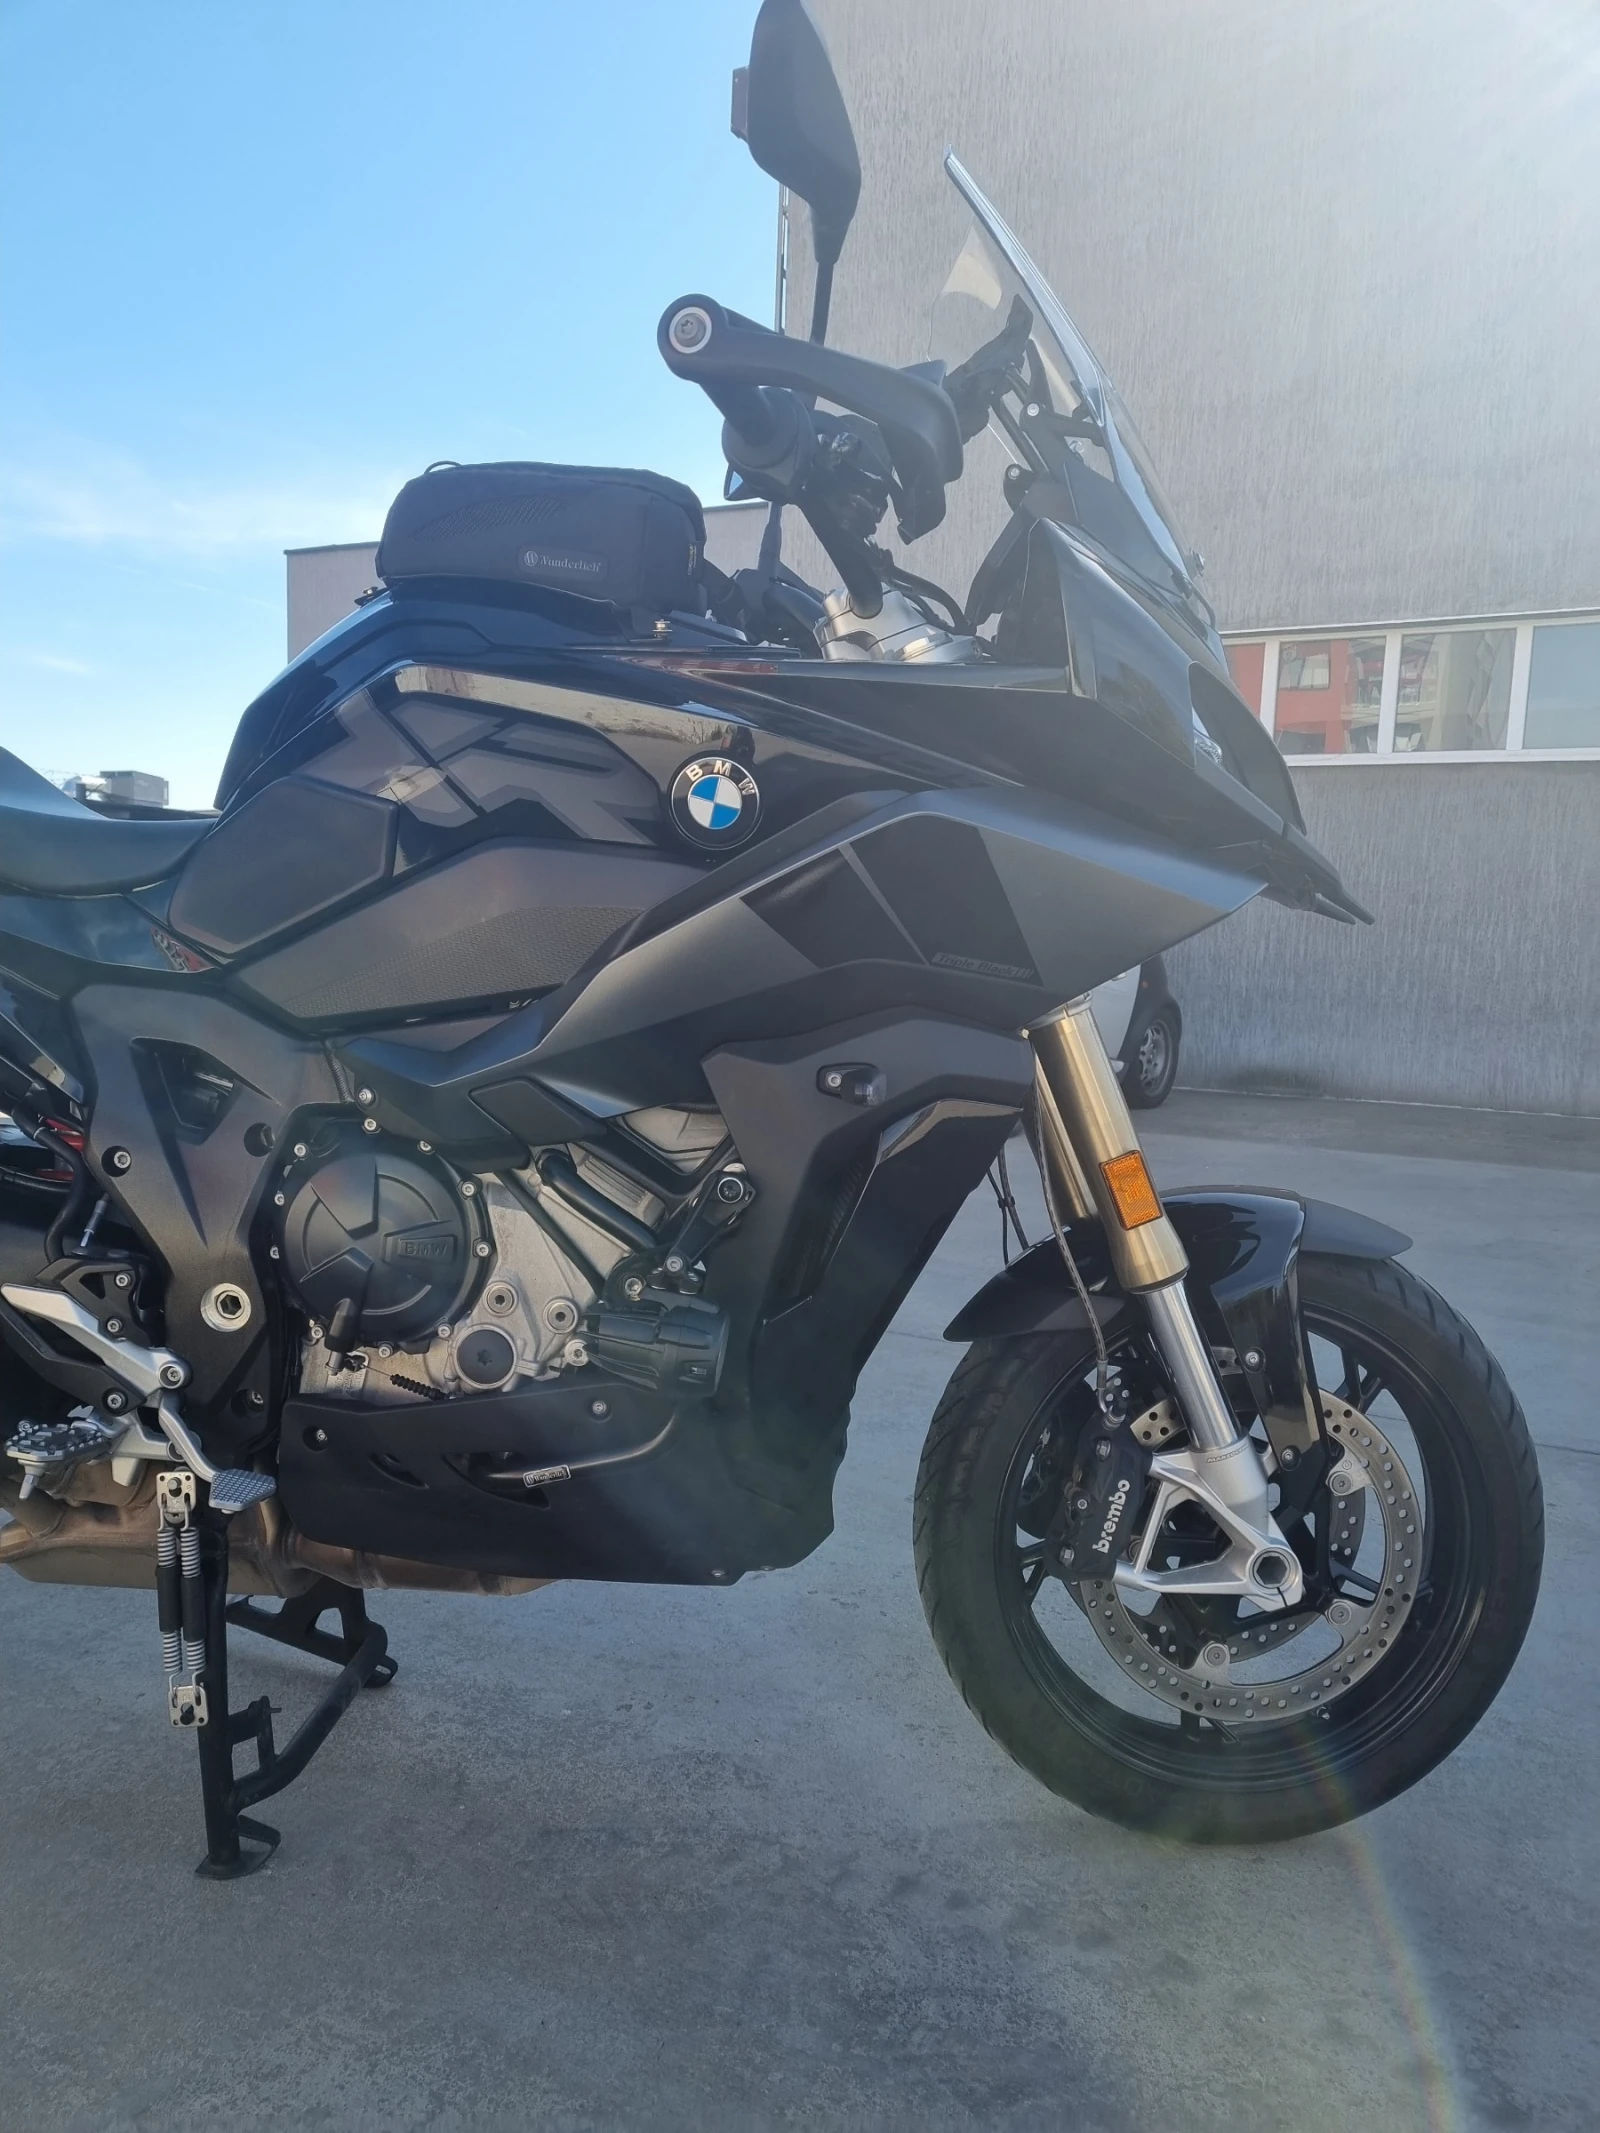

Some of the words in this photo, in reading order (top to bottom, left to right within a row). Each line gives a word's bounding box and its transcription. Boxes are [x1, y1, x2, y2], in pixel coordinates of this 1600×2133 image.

[540, 555, 602, 573] Wunderlich
[685, 760, 755, 796] BMW
[939, 954, 974, 969] Triple
[405, 1241, 448, 1256] BMW
[1092, 1480, 1130, 1553] brembo
